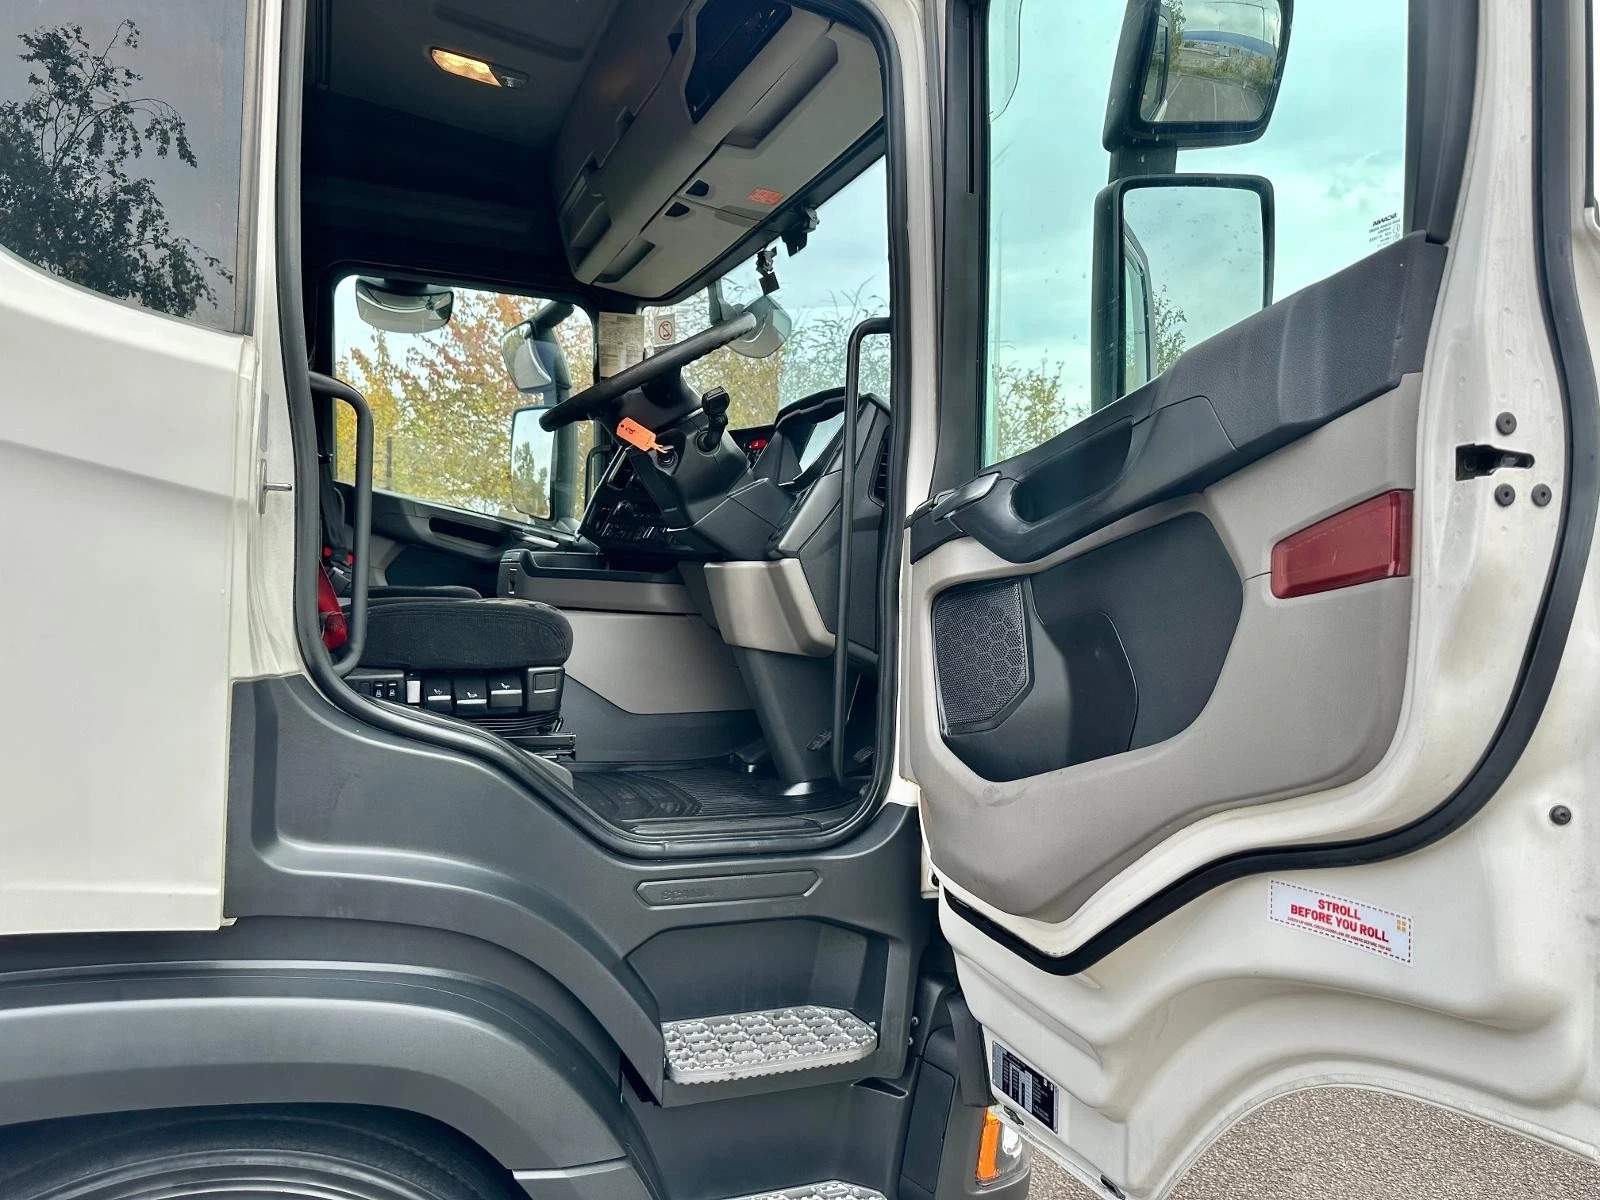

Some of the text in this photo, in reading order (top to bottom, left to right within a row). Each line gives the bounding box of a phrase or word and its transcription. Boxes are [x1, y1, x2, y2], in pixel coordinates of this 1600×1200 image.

[1290, 903, 1333, 925] BEFORE
[1335, 916, 1357, 932] YOU
[1359, 924, 1389, 943] ROLL
[1318, 899, 1361, 920] STROLL
